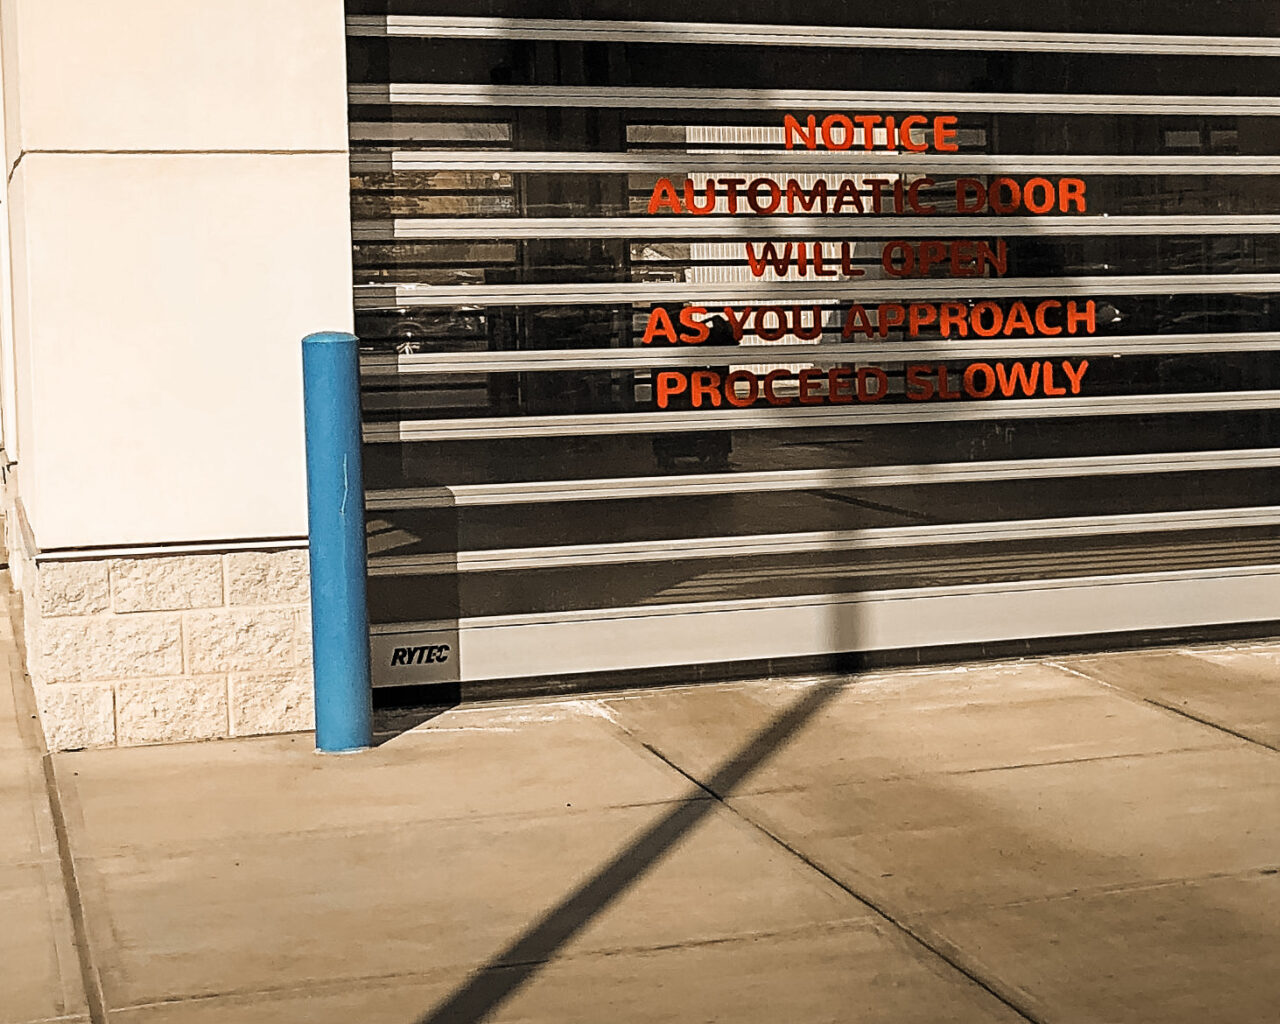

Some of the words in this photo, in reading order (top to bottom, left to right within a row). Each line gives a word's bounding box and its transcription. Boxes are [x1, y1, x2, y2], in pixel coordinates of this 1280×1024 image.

[783, 113, 959, 153] NOTICE
[647, 178, 937, 216] AUTOMATIC
[955, 176, 1088, 216] DOOR
[746, 241, 865, 277] WILL
[881, 240, 1008, 276] OPEN
[642, 306, 710, 344] AS
[723, 304, 822, 341] YOU
[842, 299, 1097, 339] APPROACH
[656, 365, 888, 409] PROCEED
[906, 360, 1089, 401] SLOWLY
[390, 644, 450, 666] RYTEC
